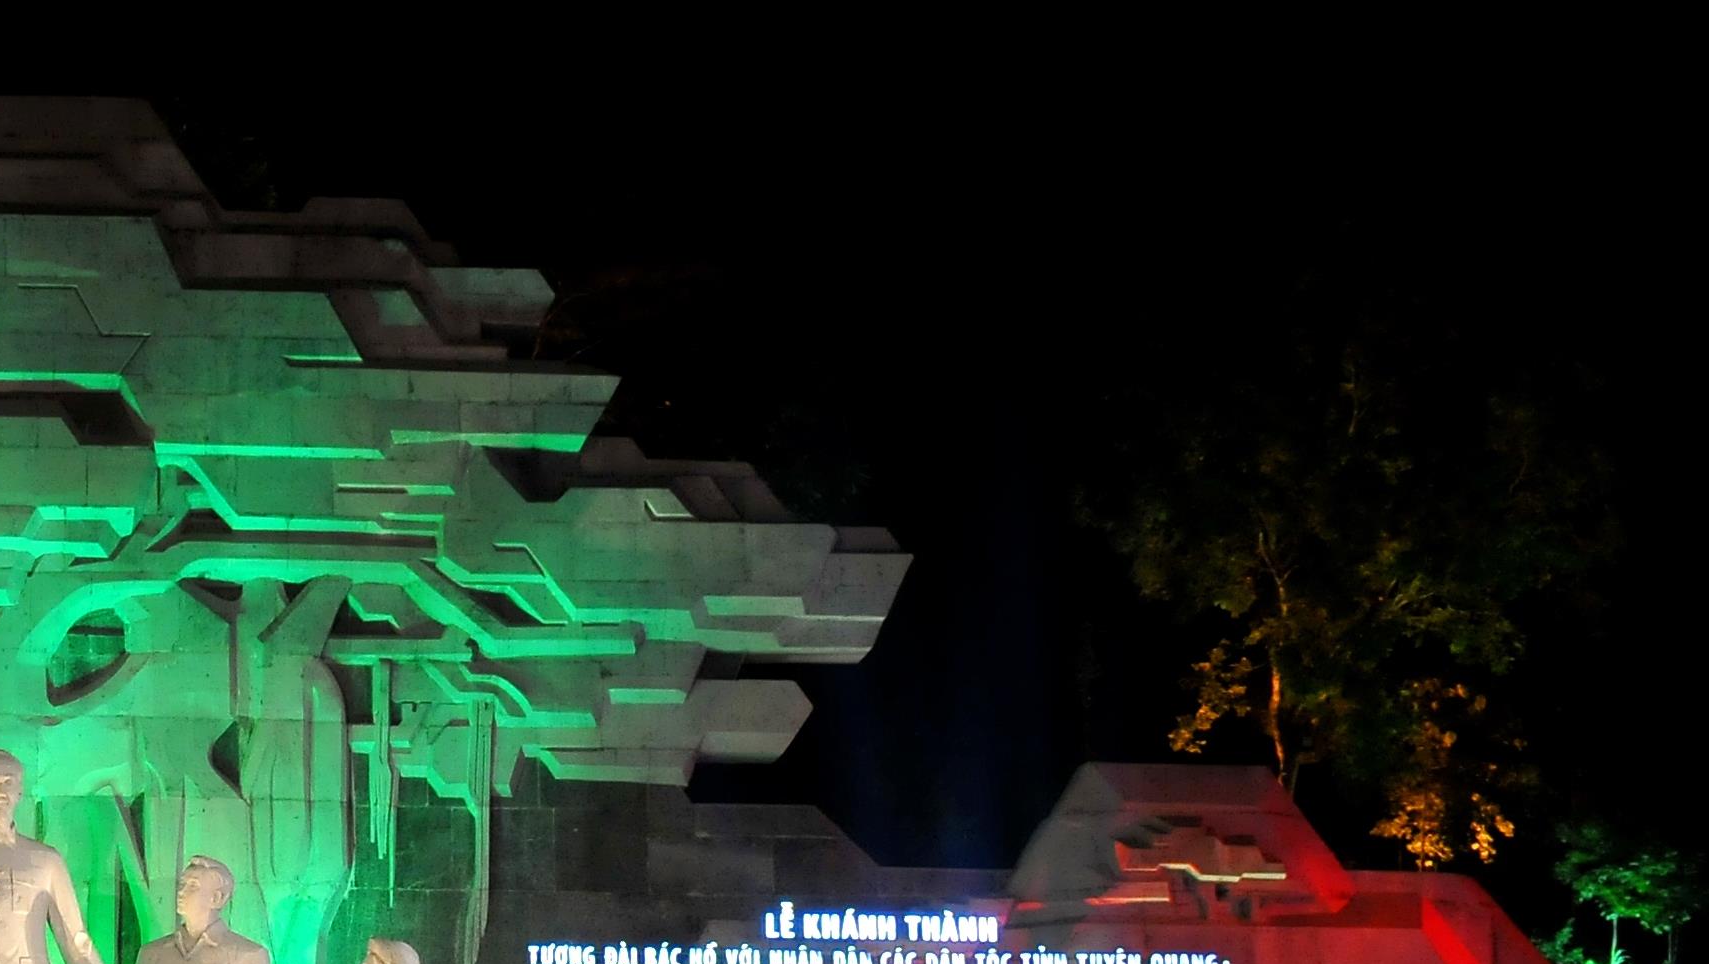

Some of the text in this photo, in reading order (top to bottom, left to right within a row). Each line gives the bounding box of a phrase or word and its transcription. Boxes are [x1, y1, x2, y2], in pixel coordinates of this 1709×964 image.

[765, 901, 998, 943] LỄ KHÁNH THÀNH
